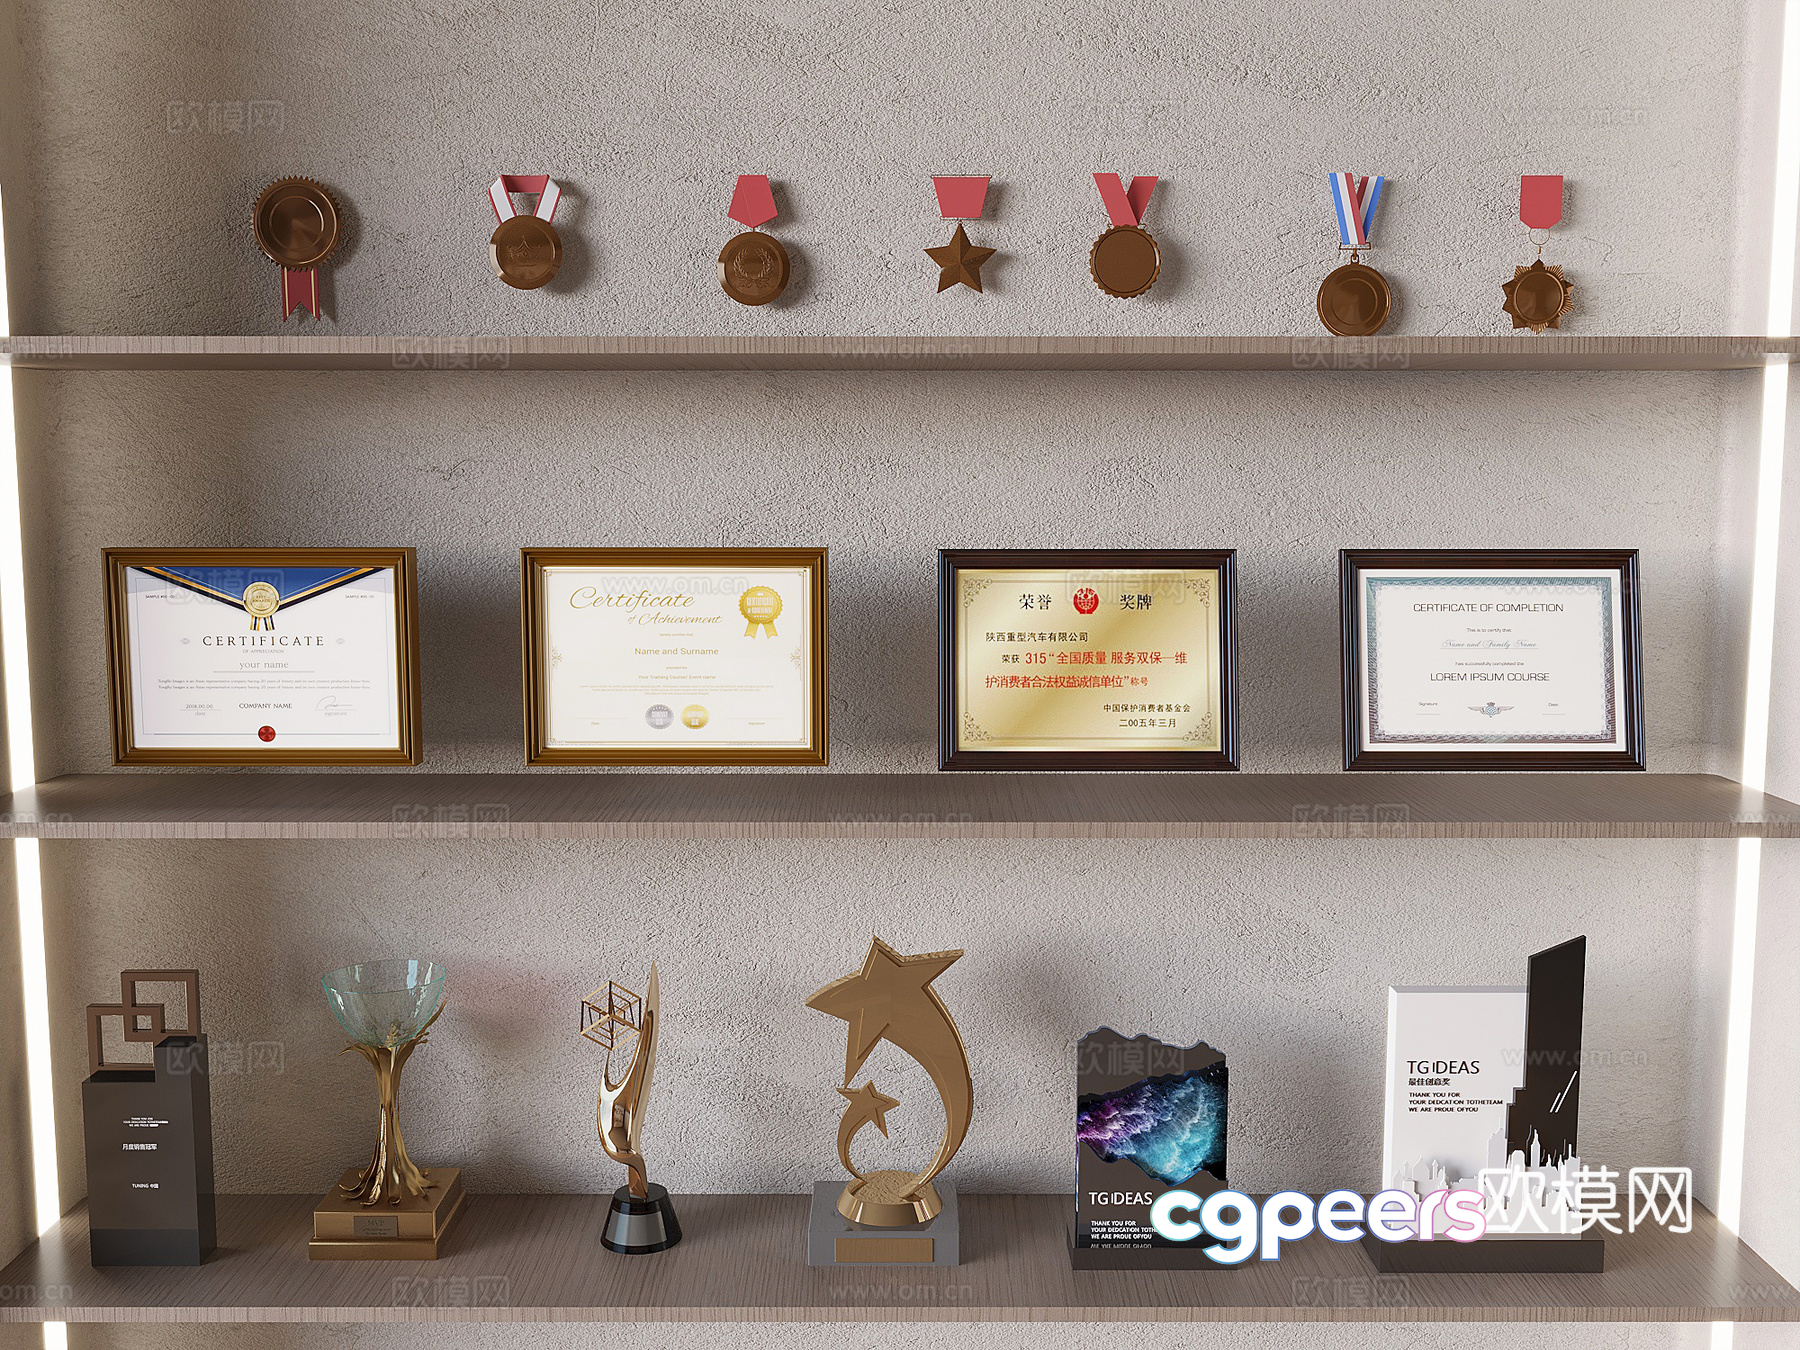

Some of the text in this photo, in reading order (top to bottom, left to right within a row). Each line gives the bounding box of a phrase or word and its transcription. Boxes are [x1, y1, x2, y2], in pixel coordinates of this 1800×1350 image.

[570, 586, 696, 613] Certificate
[1019, 594, 1152, 610] 荣誉 奖牌
[1413, 603, 1564, 612] CERTIFICATE OF COMPLETION
[628, 612, 723, 625] of Achievement
[202, 635, 325, 647] CERTIFICATE
[985, 632, 1089, 643] 陕西重型汽车有限公司
[1001, 654, 1020, 664] 荣获
[240, 662, 260, 670] your
[1430, 673, 1550, 681] LOREM IPSUM COURSE
[1103, 704, 1191, 713] 中国保护消费者基金会
